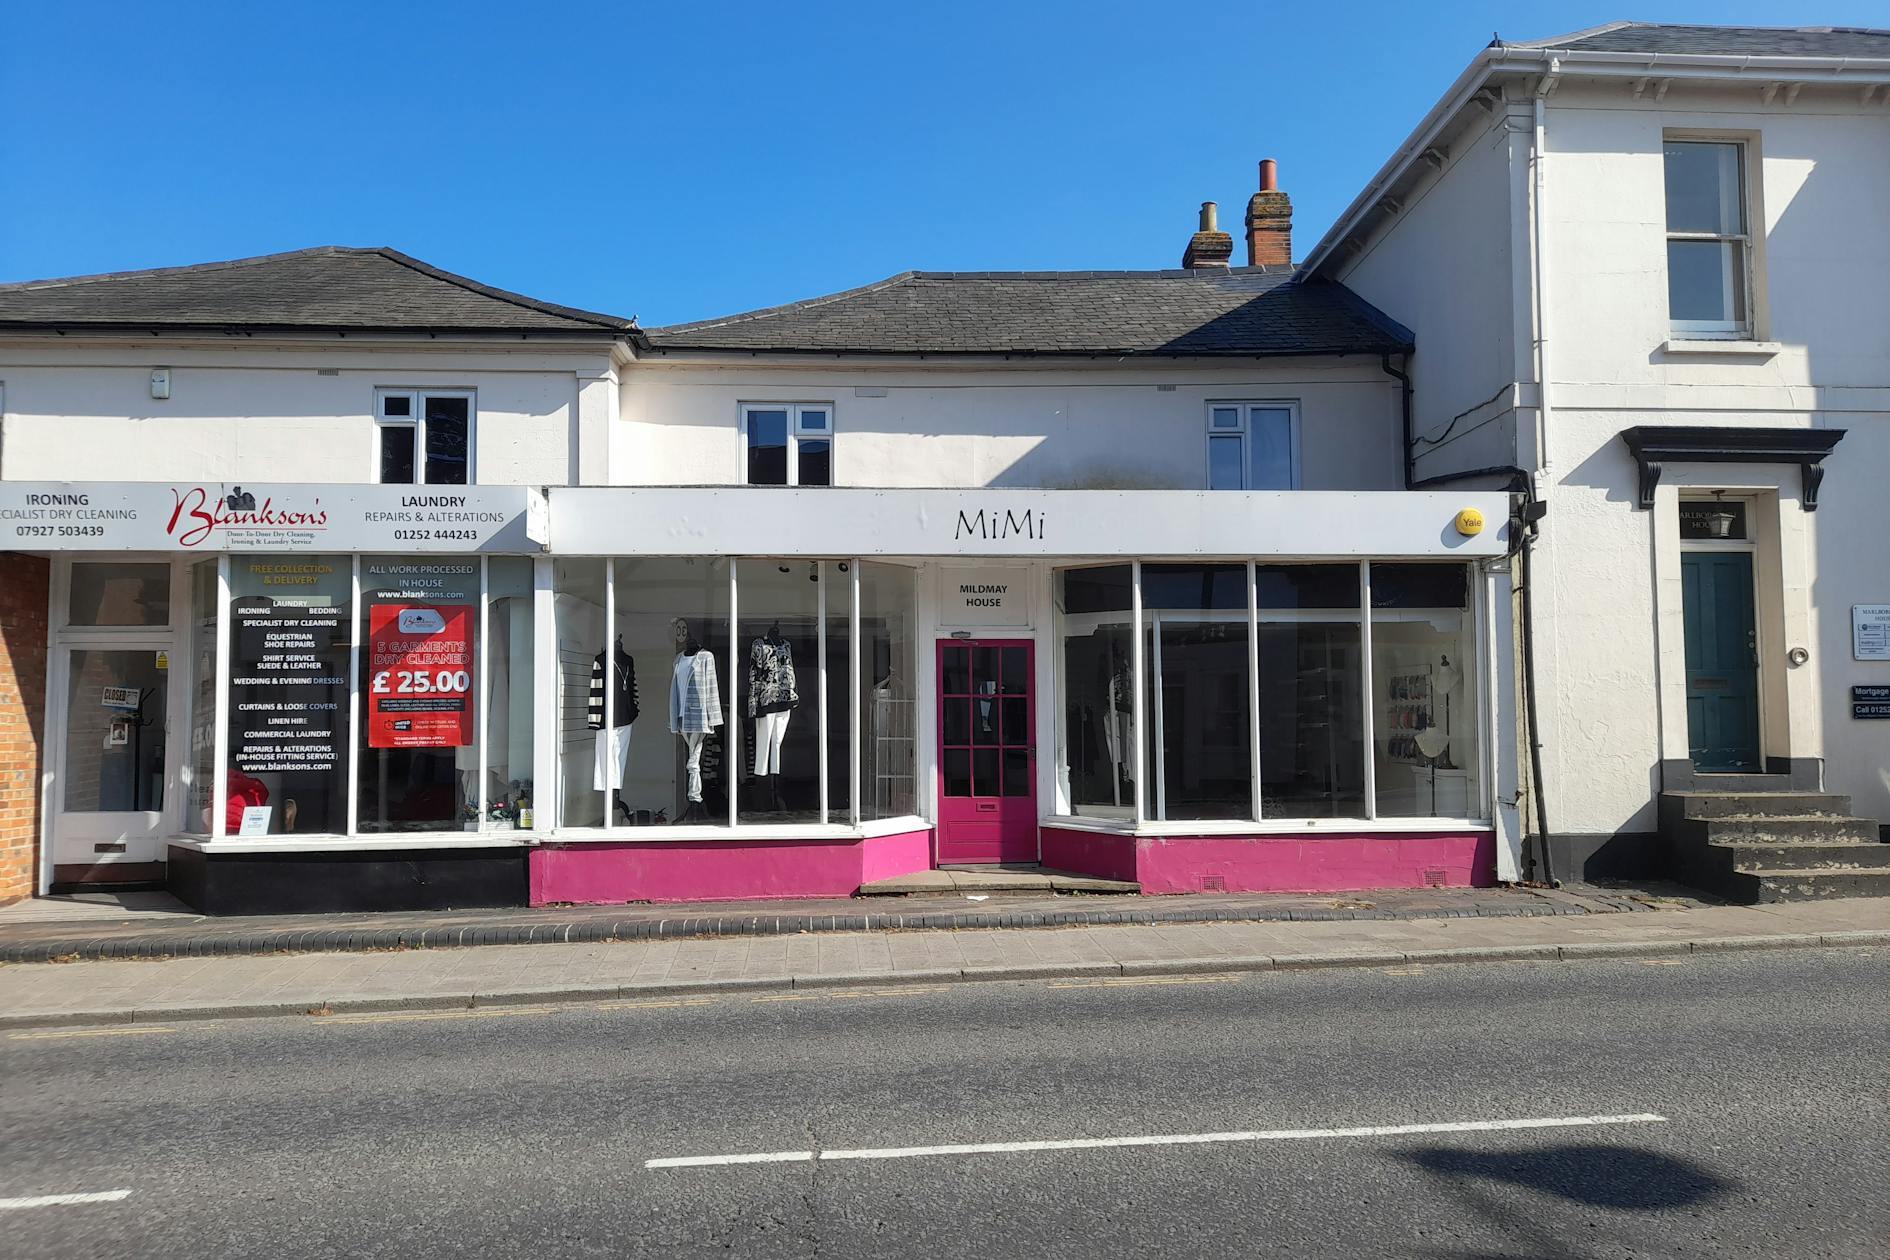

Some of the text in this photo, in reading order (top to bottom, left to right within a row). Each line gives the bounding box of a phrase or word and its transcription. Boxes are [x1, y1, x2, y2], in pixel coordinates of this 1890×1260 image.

[26, 494, 89, 506] IRONING
[401, 496, 466, 507] LAUNDRY
[0, 509, 137, 520] CIALIST DRY CLEANING
[166, 487, 328, 546] Blankson's
[364, 511, 504, 523] REPAIRS & ALTERATIONS
[954, 509, 1046, 540] MiMi
[1463, 518, 1482, 527] Yale
[16, 526, 104, 537] 07927 503439
[394, 529, 477, 541] 01252 444243
[250, 565, 333, 574] FREE COLLECTION
[369, 566, 473, 574] ALL WORK PROCESSED
[263, 576, 318, 584] & DELIVERY
[399, 579, 444, 587] IN HOUSE
[377, 590, 464, 598] www.blanksons.com
[959, 585, 1008, 594] MILDMAY
[966, 598, 1001, 607] HOUSE
[377, 641, 467, 652] 5 GARMENTS
[374, 654, 470, 665] DRY CLEANED
[372, 671, 471, 693] £ 25.00
[1855, 688, 1889, 696] Mortgage
[236, 753, 338, 761] (IN-HOUSE FITTING SERVICE)
[242, 763, 331, 771] www.blanksons.com
